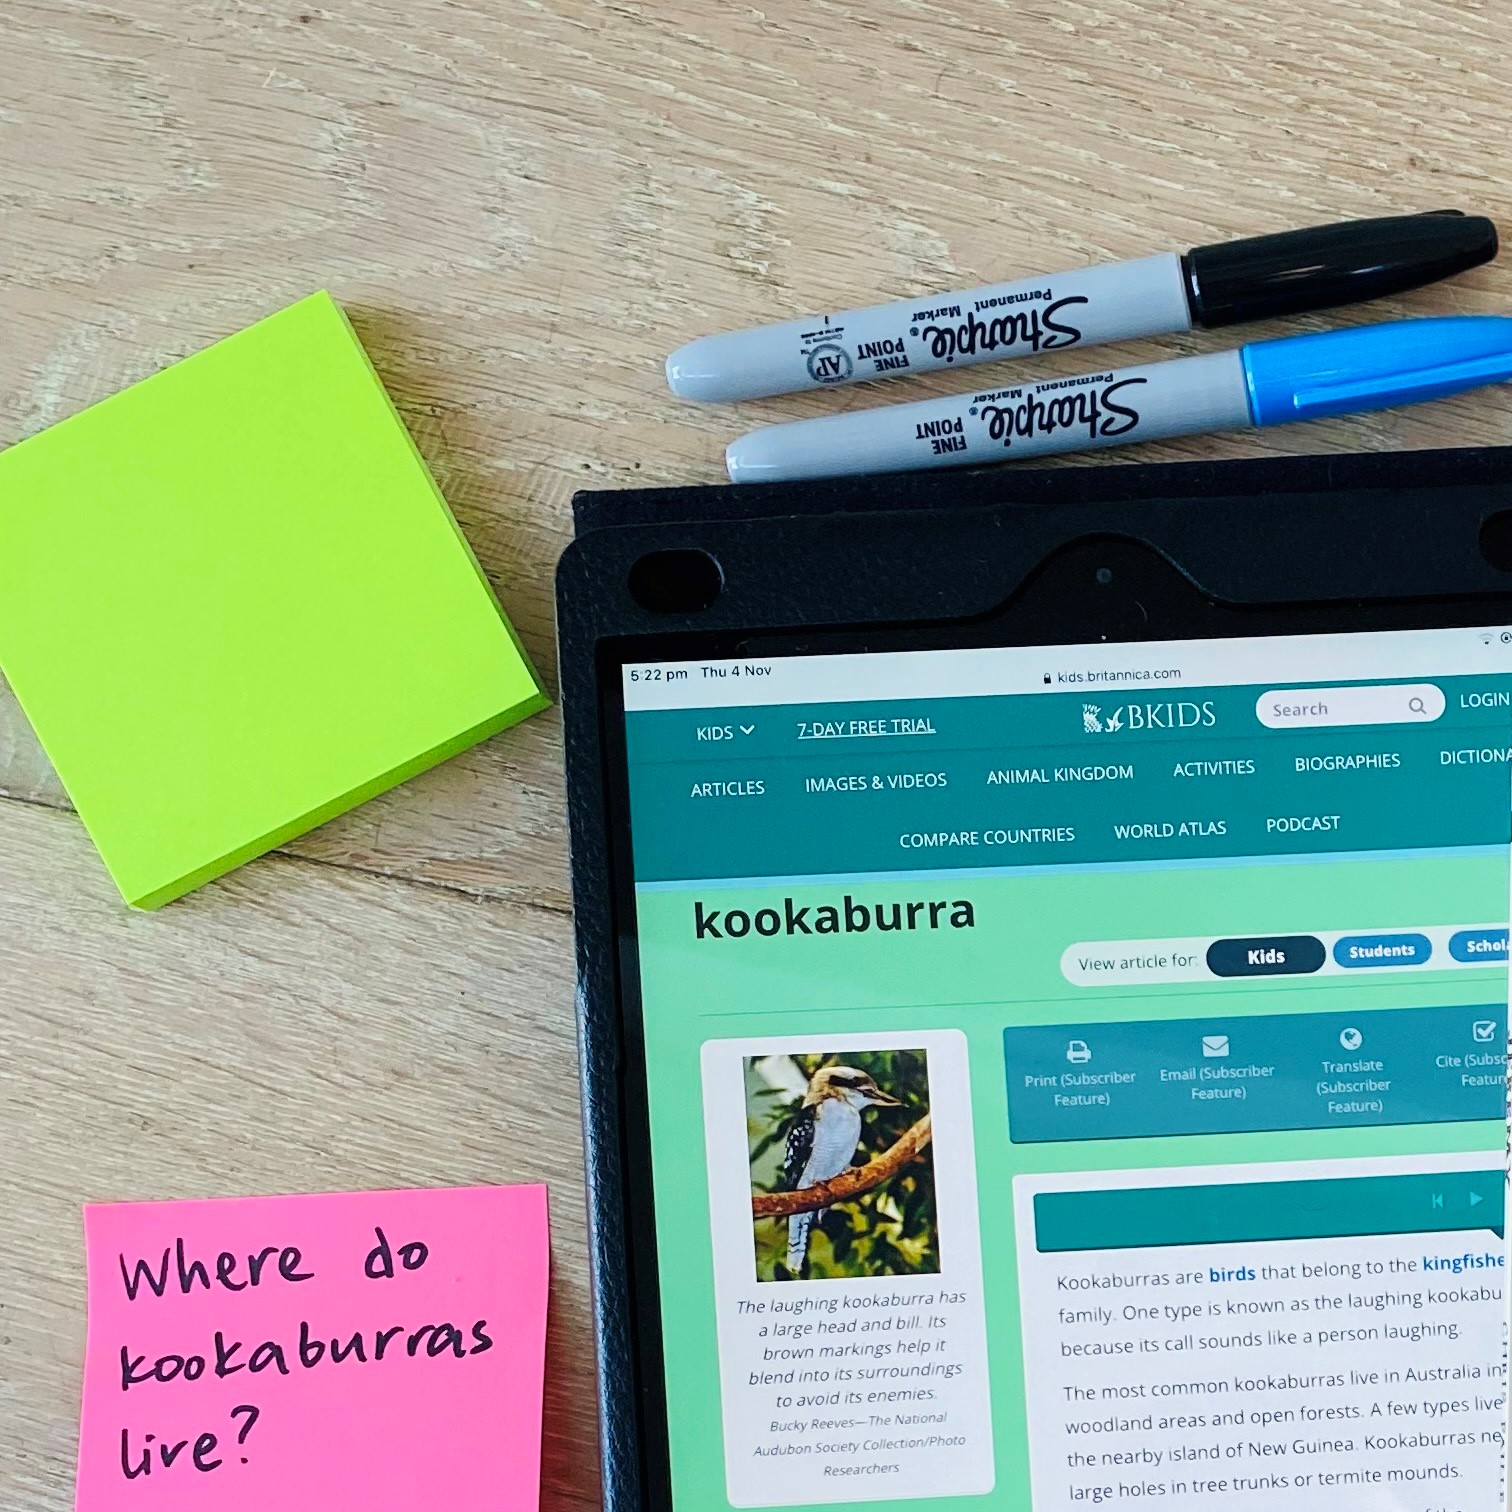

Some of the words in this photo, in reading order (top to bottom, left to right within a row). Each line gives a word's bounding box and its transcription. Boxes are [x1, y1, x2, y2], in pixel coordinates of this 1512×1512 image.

[974, 287, 1053, 313] Permanent
[911, 304, 962, 325] Marker
[856, 337, 906, 360] POINT
[874, 353, 910, 373] FINE
[1035, 372, 1115, 394] Permanent
[972, 387, 1023, 406] Marker
[915, 416, 965, 439] POINT
[930, 435, 968, 456] FINE
[630, 668, 663, 683] 5:22
[666, 668, 689, 683] pm
[701, 665, 728, 680] Thu
[731, 664, 742, 679] 4
[744, 665, 771, 676] Nov
[1057, 669, 1181, 682] kids.britannica.com
[1273, 701, 1328, 716] Search
[1460, 692, 1509, 707] LOGIN
[1127, 701, 1215, 728] BKIDS
[696, 725, 733, 740] KIDS
[797, 722, 846, 739] 7-DAY
[849, 719, 887, 736] FREE
[892, 717, 936, 735] TRIAL
[1173, 759, 1255, 776] ACTIVITIES
[1295, 753, 1400, 771] BIOGRAPHIES
[805, 776, 867, 792] IMAGES
[871, 775, 884, 789] &
[886, 772, 947, 788] VIDEOS
[986, 768, 1049, 784] ANIMAL
[1054, 764, 1133, 781] KINGDOM
[690, 780, 764, 797] ARTICLES
[1113, 823, 1173, 839] WORLD
[1178, 820, 1226, 836] ATLAS
[1266, 815, 1340, 832] PODCAST
[899, 831, 979, 848] COMPARE
[983, 827, 1075, 844] COUNTRIES
[694, 895, 974, 938] kookaburra
[1248, 948, 1285, 964] Kids
[1349, 944, 1415, 958] Students
[1078, 957, 1115, 970] View
[1120, 954, 1167, 969] article
[1159, 1067, 1196, 1081] Email
[1199, 1064, 1274, 1081] (Subscriber
[1321, 1059, 1383, 1073] Translate
[1024, 1074, 1057, 1087] Print
[1060, 1071, 1136, 1088] (Subscriber
[1316, 1078, 1391, 1096] (Subscriber
[1054, 1092, 1110, 1106] Feature)
[1191, 1085, 1246, 1099] Feature)
[1327, 1099, 1383, 1113] Feature)
[120, 1237, 314, 1300] Where
[365, 1227, 429, 1278] do
[1057, 1273, 1169, 1290] Kookaburras
[1175, 1272, 1203, 1284] are
[1209, 1265, 1256, 1282] birds
[1261, 1264, 1296, 1279] that
[1302, 1261, 1361, 1279] belong
[1365, 1261, 1383, 1274] to
[1388, 1258, 1416, 1272] the
[736, 1300, 765, 1314] The
[770, 1297, 838, 1315] laughing
[842, 1292, 933, 1308] kookaburra
[938, 1289, 966, 1303] has
[758, 1326, 767, 1337] a
[772, 1322, 812, 1339] large
[817, 1318, 857, 1333] head
[860, 1316, 892, 1331] and
[121, 1320, 493, 1391] kookaburras
[763, 1347, 813, 1360] brown
[818, 1342, 892, 1358] markings
[896, 1338, 930, 1355] help
[935, 1339, 945, 1351] it
[748, 1369, 794, 1385] blend
[798, 1370, 829, 1382] into
[834, 1368, 852, 1380] its
[856, 1361, 962, 1379] surroundings
[776, 1396, 792, 1407] to
[796, 1390, 840, 1406] avoid
[844, 1392, 862, 1403] its
[122, 1405, 259, 1479] live?
